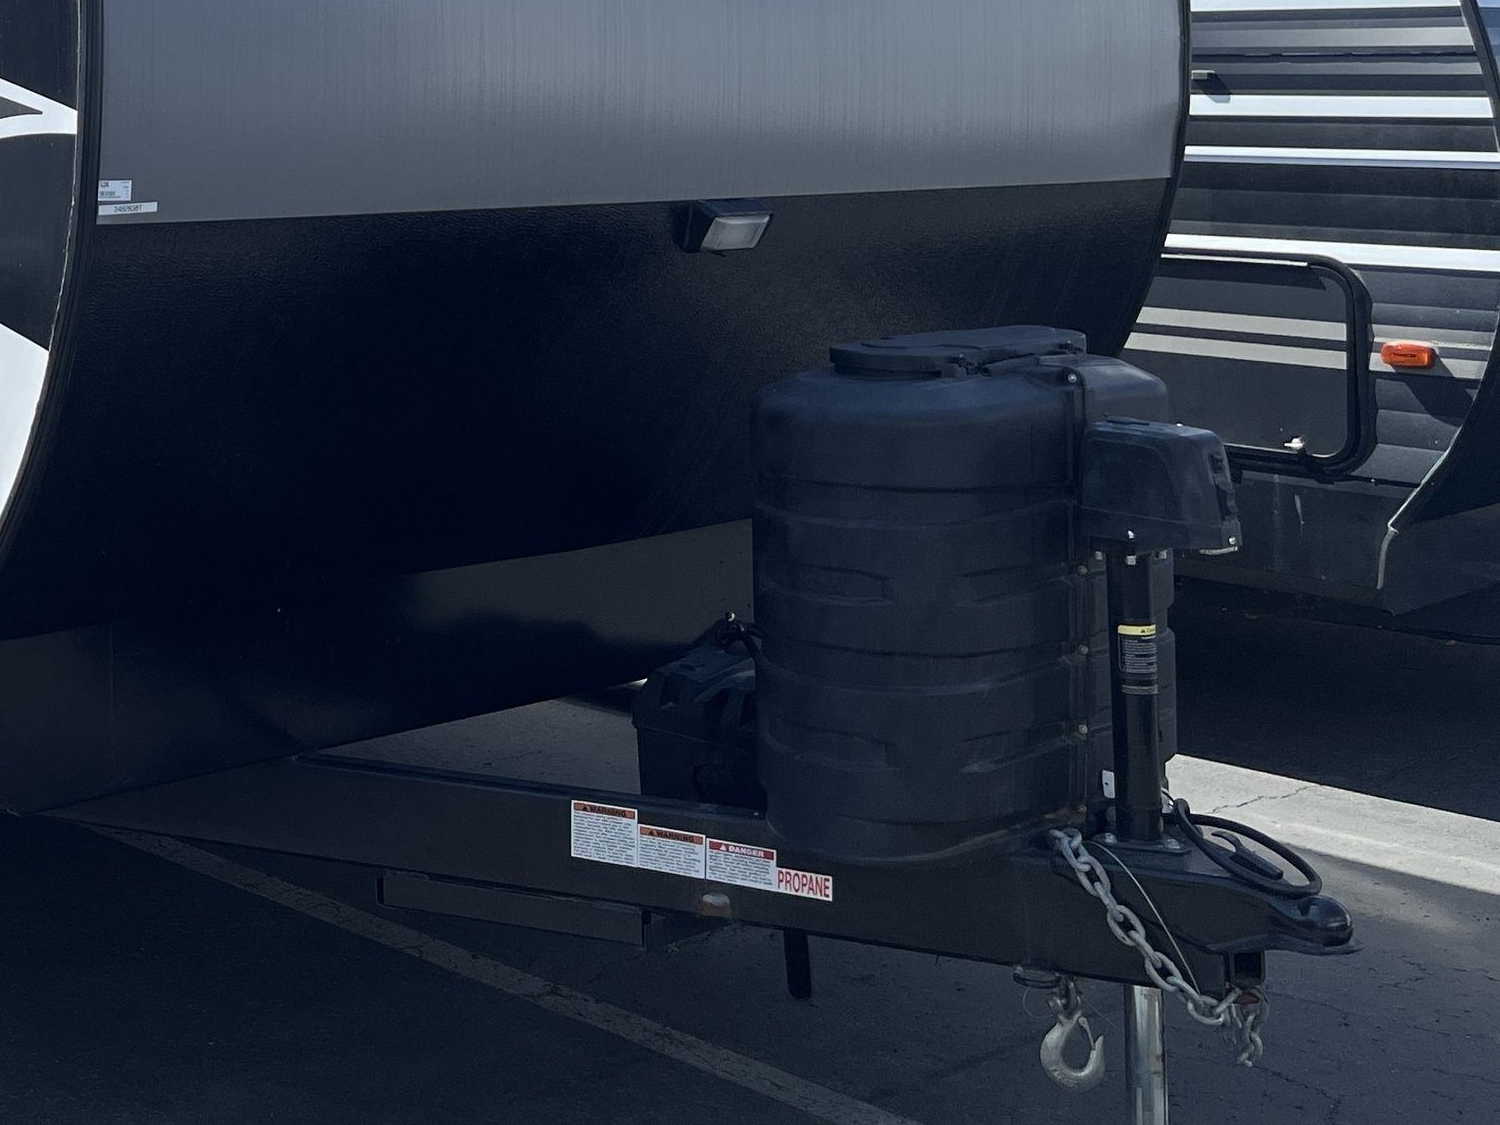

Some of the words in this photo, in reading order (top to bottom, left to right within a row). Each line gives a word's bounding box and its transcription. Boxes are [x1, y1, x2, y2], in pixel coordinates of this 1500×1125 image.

[589, 805, 627, 818] WARNING
[657, 829, 695, 842] WARNING
[728, 845, 765, 858] DANGER
[777, 869, 831, 898] PROPANE
